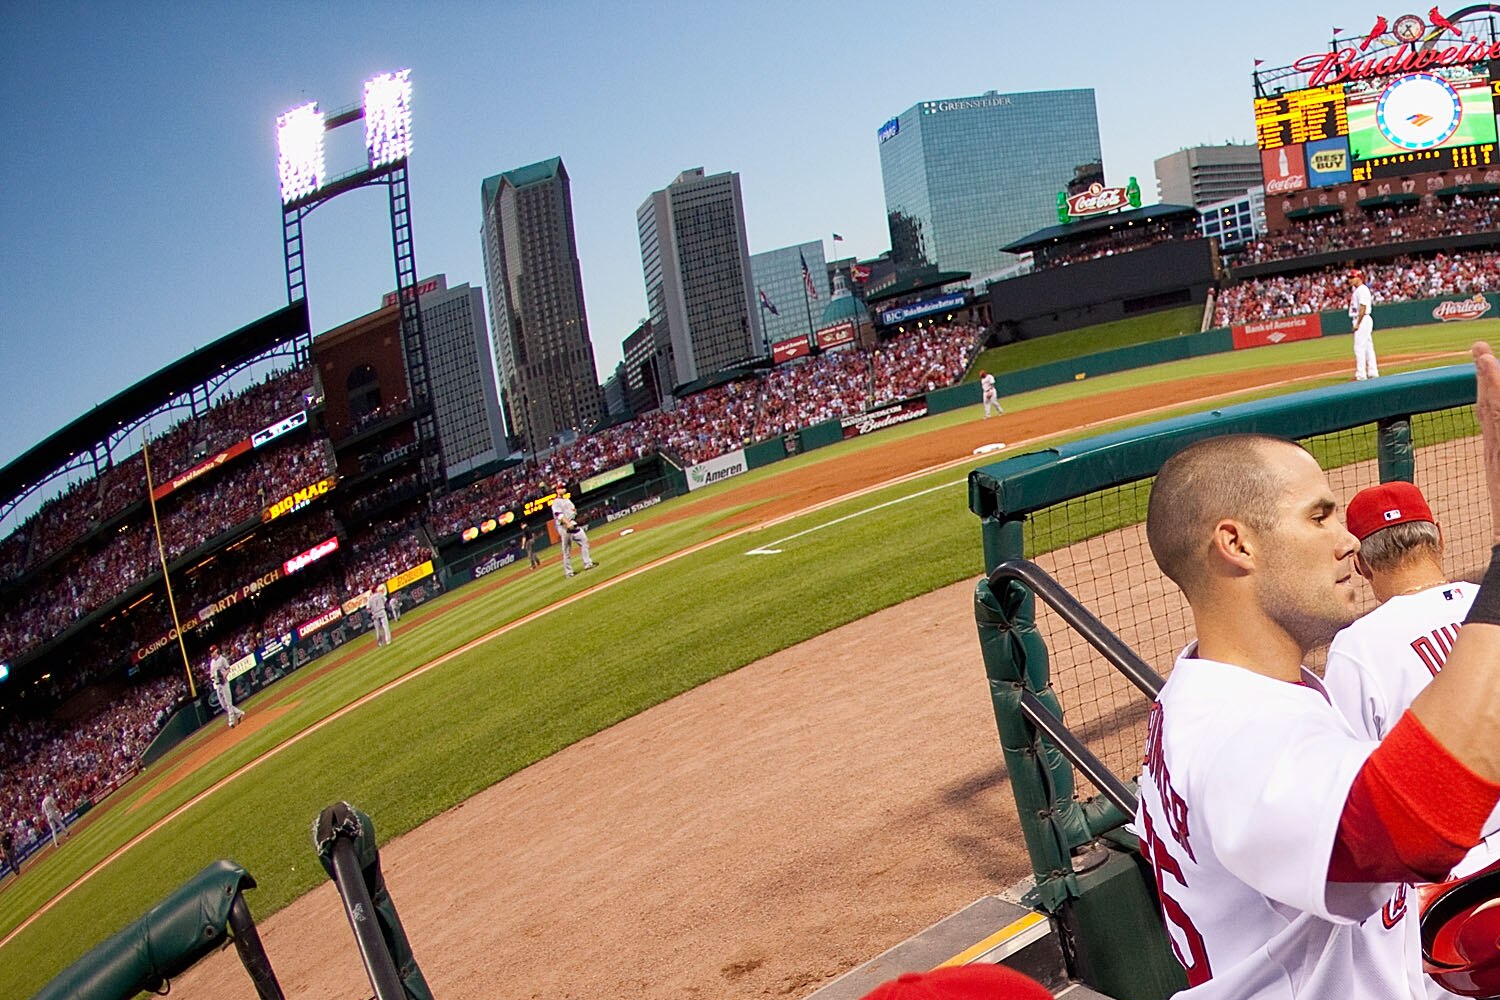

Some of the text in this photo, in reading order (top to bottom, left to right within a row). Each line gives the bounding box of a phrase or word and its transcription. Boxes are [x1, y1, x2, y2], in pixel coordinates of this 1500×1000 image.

[1315, 152, 1345, 163] BEST
[1317, 161, 1342, 170] BUY
[885, 309, 903, 323] BJC
[1245, 323, 1265, 334] Bank
[1274, 319, 1307, 329] America
[856, 407, 928, 435] Budweiser
[705, 463, 743, 484] Ameren
[269, 480, 329, 519] BIG MAC
[607, 496, 661, 522] BUSCH STADIUM
[475, 553, 515, 578] Scottrade
[300, 606, 342, 637] CARDINALS.COM
[136, 636, 168, 660] CASINO
[168, 618, 198, 641] QEEN
